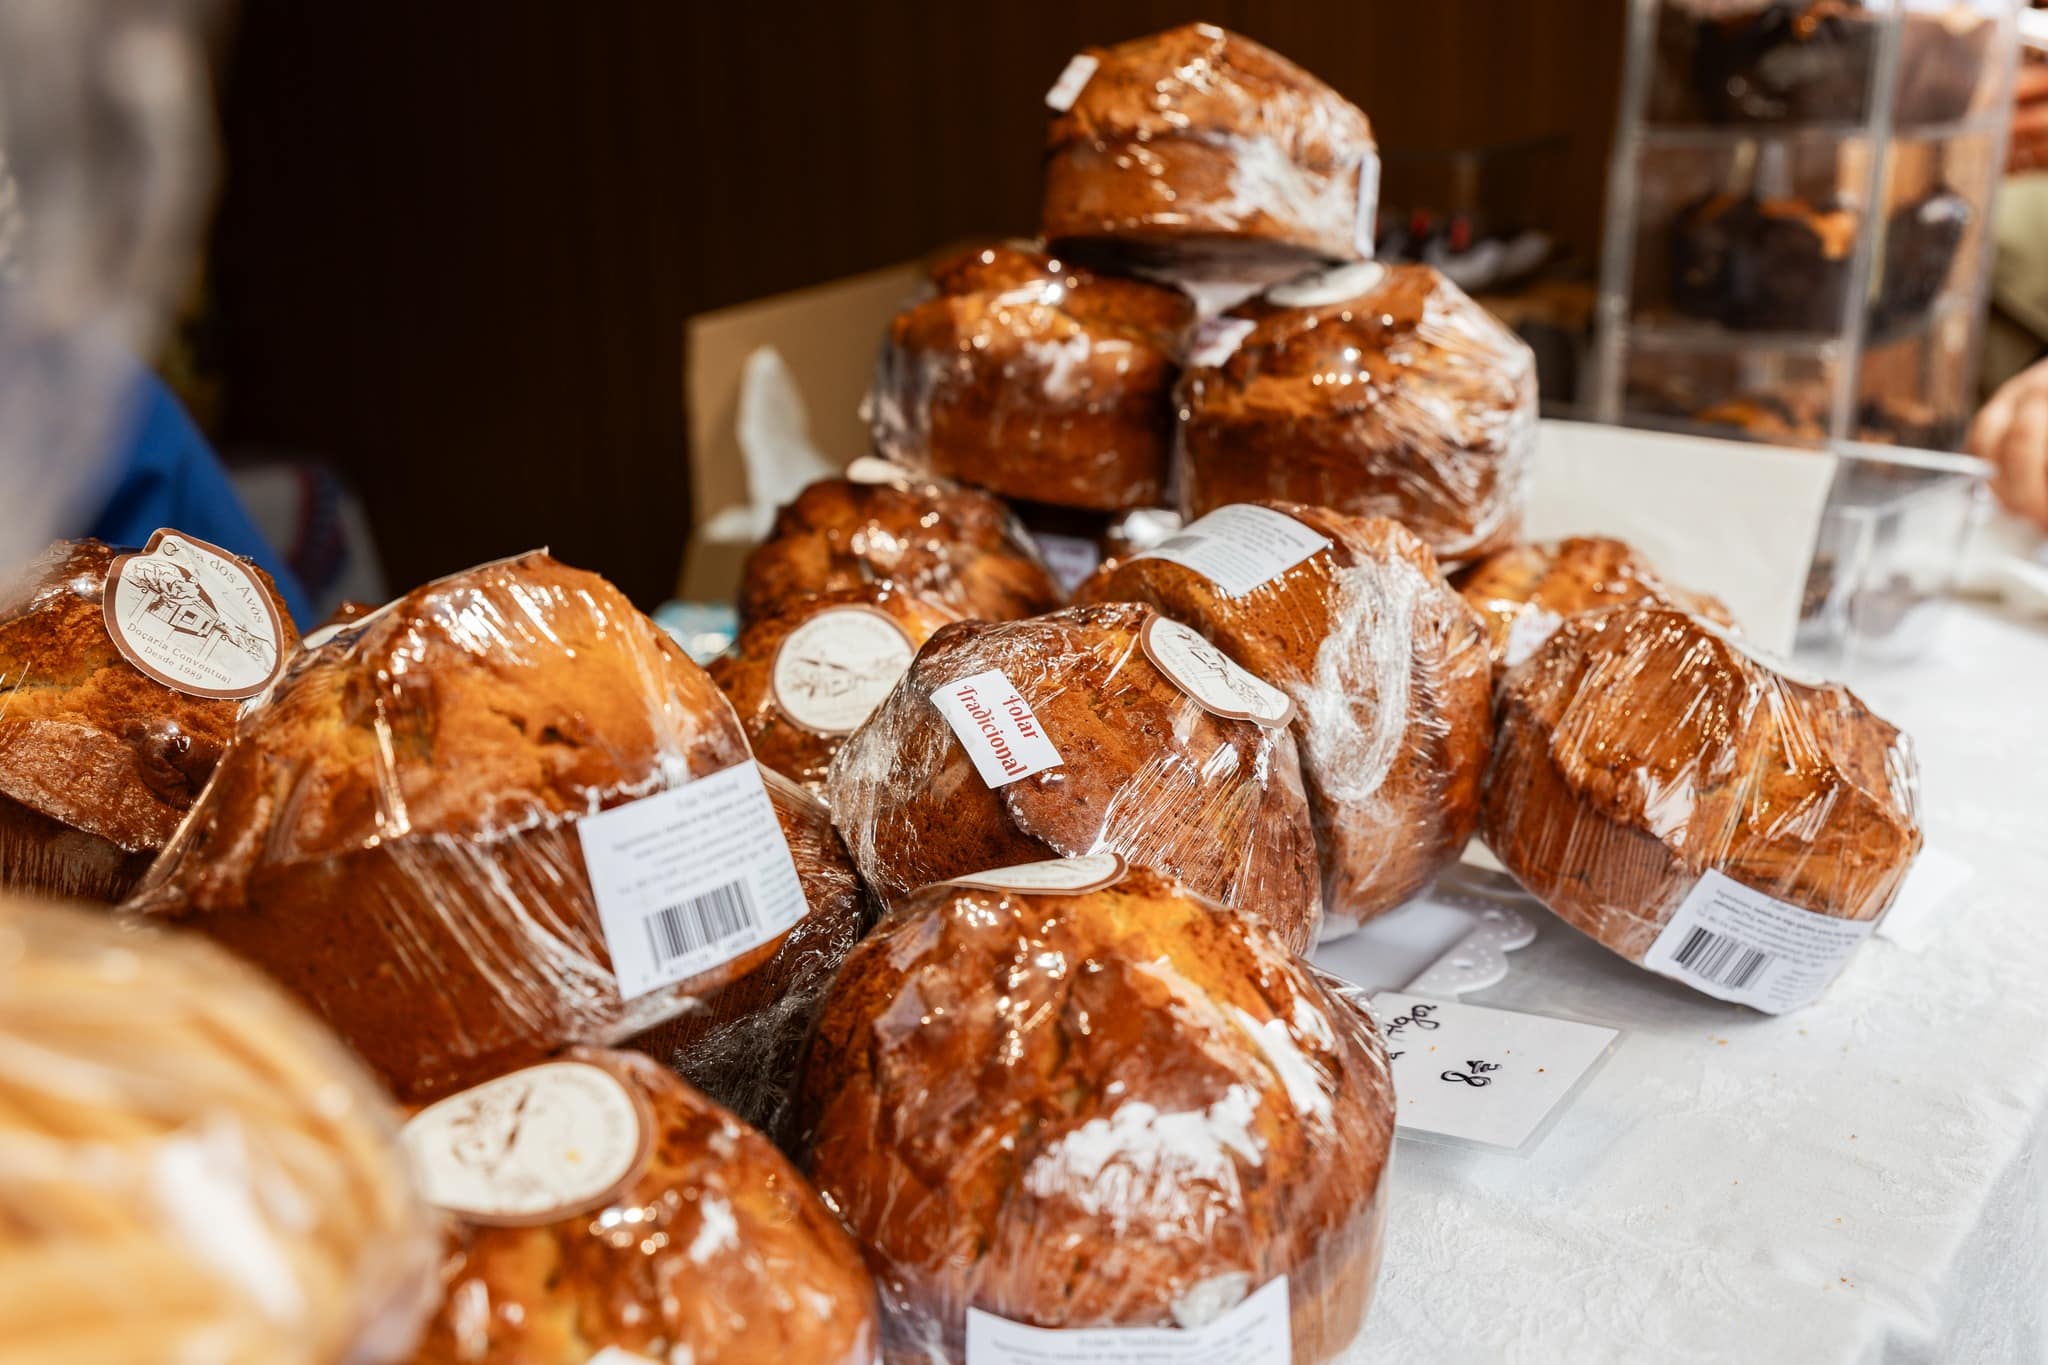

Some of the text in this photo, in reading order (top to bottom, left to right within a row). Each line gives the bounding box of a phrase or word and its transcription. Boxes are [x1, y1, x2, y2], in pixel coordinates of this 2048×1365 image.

[210, 559, 237, 584] dos
[127, 622, 232, 684] Doçaria Conventual
[144, 646, 202, 681] Desde 1989
[956, 685, 1028, 776] Tradicional
[1002, 694, 1039, 740] Folar
